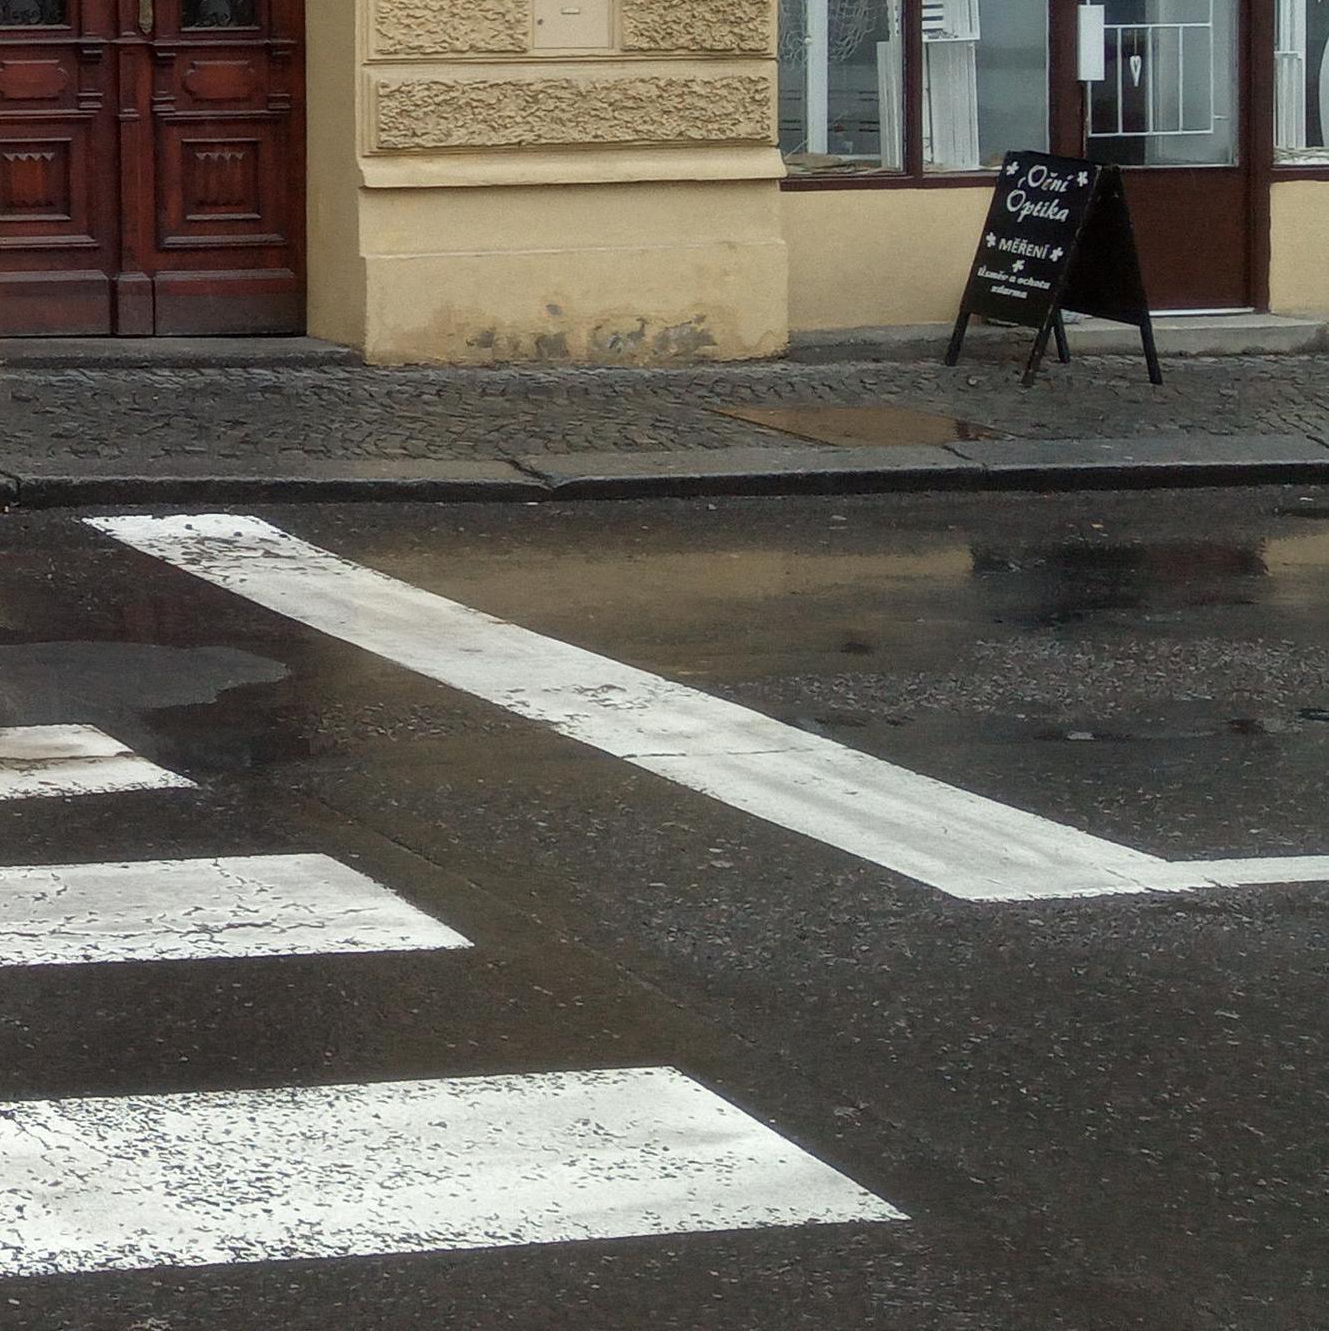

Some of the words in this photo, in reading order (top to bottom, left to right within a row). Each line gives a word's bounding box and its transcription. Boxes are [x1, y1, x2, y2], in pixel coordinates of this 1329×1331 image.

[1027, 165, 1074, 193] Oční
[1006, 188, 1070, 222] Optika
[998, 237, 1050, 260] MĚŘENÍ
